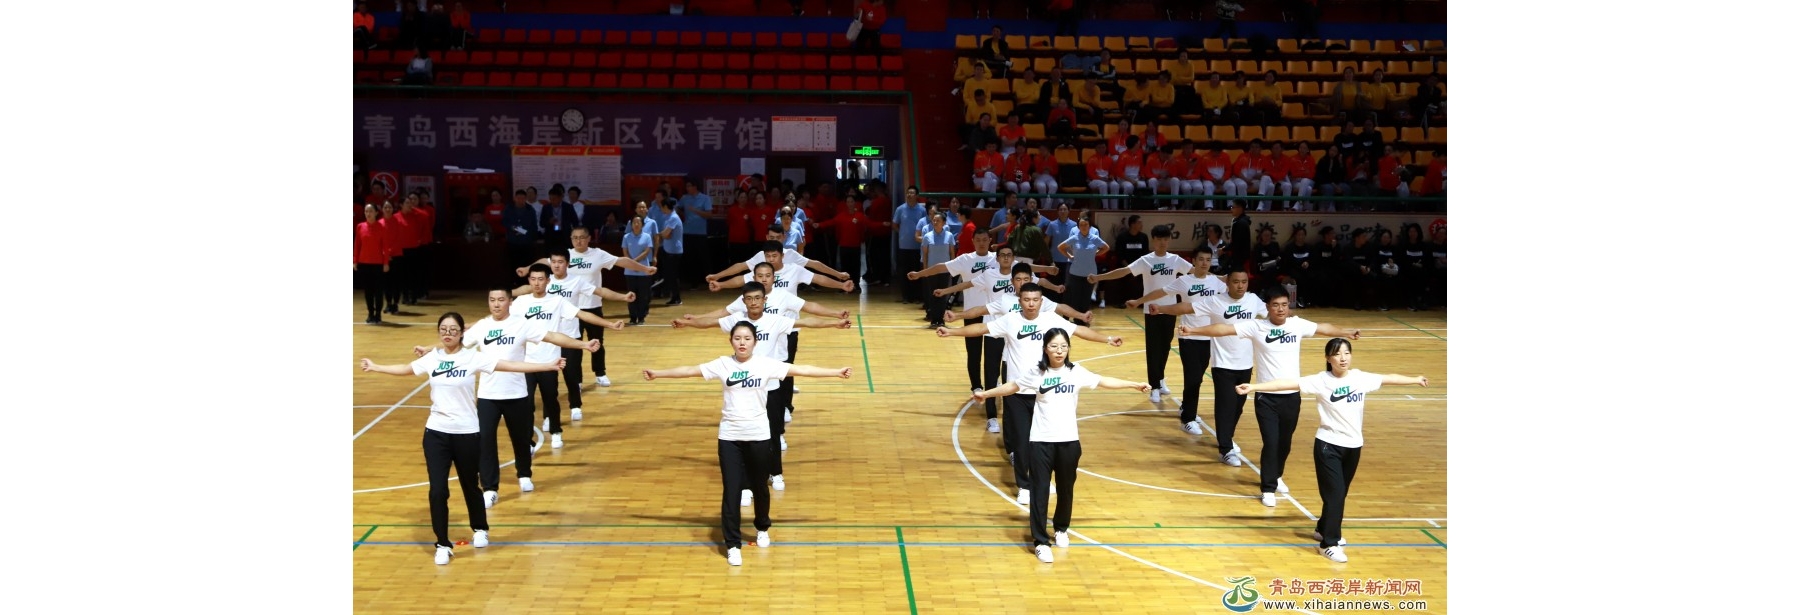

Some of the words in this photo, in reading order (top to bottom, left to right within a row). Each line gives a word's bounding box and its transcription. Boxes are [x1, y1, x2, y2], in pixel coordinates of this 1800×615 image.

[363, 114, 768, 150] 青岛西海岸新区体育馆
[487, 329, 503, 338] JUST
[437, 361, 454, 370] JUST
[731, 371, 749, 379] JUST
[1043, 377, 1061, 386] JUST
[1333, 386, 1350, 394] JUST
